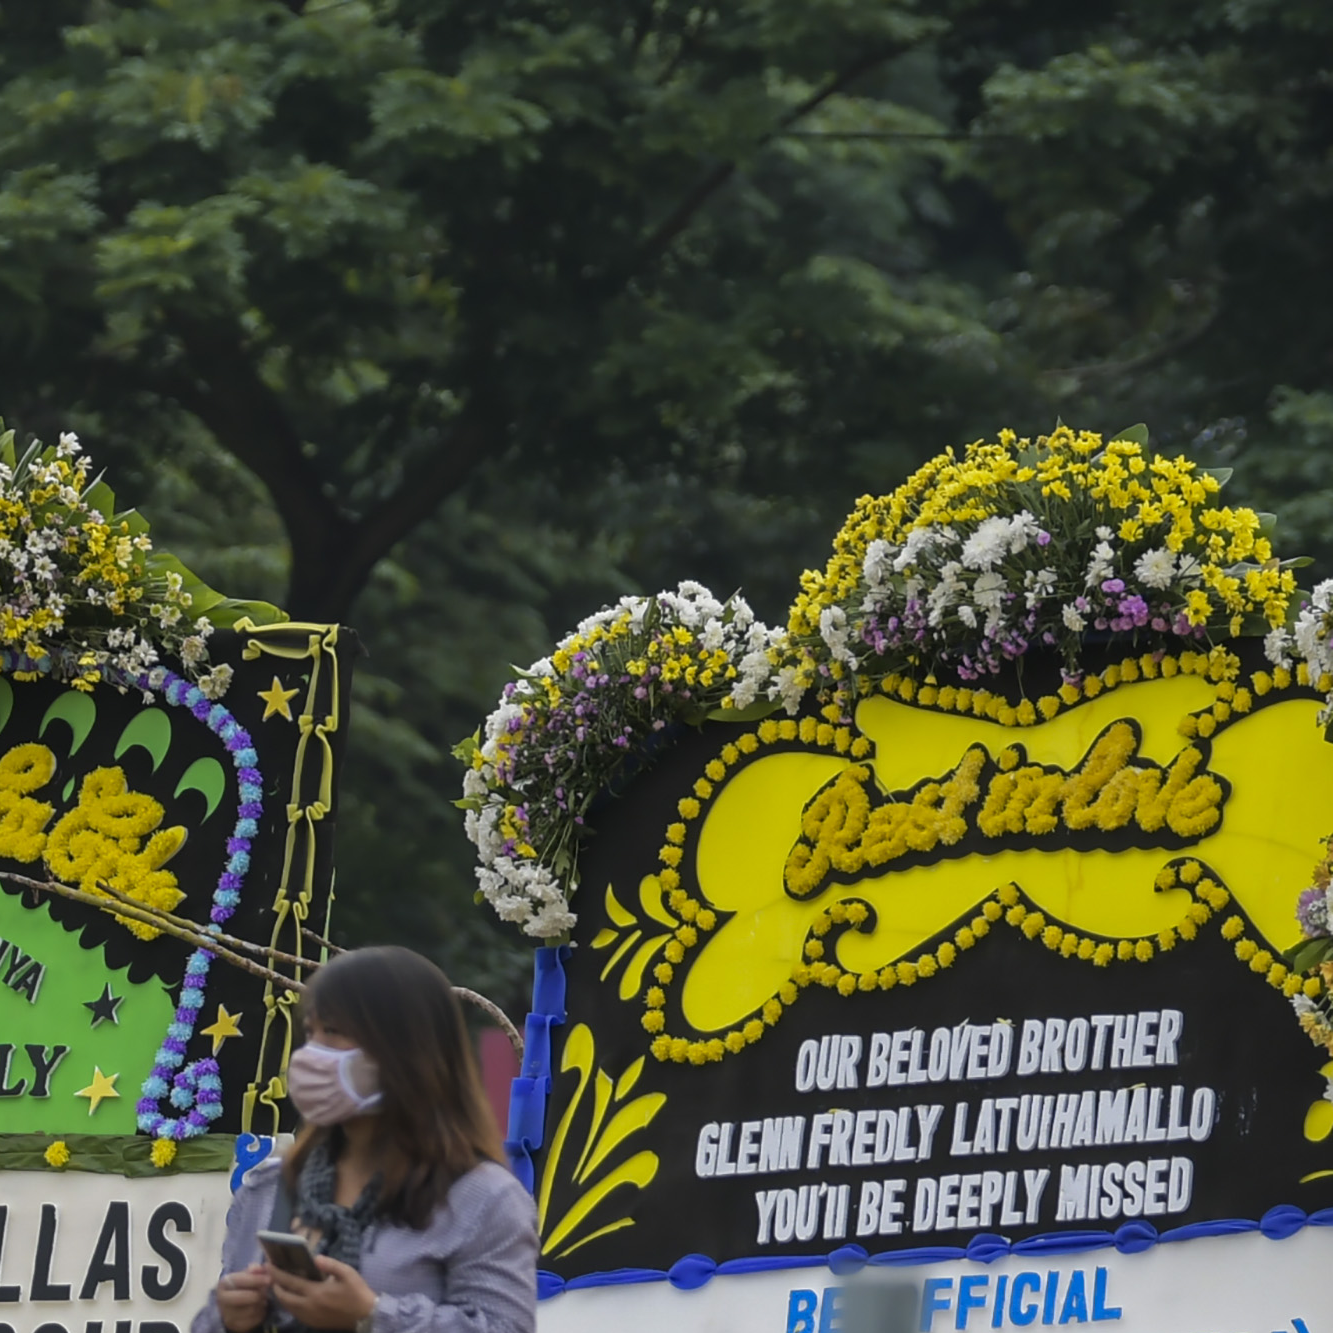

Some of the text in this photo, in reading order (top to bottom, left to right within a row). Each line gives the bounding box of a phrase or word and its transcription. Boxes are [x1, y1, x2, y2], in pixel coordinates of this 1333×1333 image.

[795, 1010, 1183, 1093] OUR BELOVED BROTHER
[695, 1086, 1216, 1178] GLENN FREDLY LATUIHAMALLO
[856, 1178, 907, 1237] BE
[914, 1168, 1051, 1233] DEEPLY
[1055, 1156, 1194, 1221] MISSED
[920, 1266, 1122, 1332] FFICIAL
